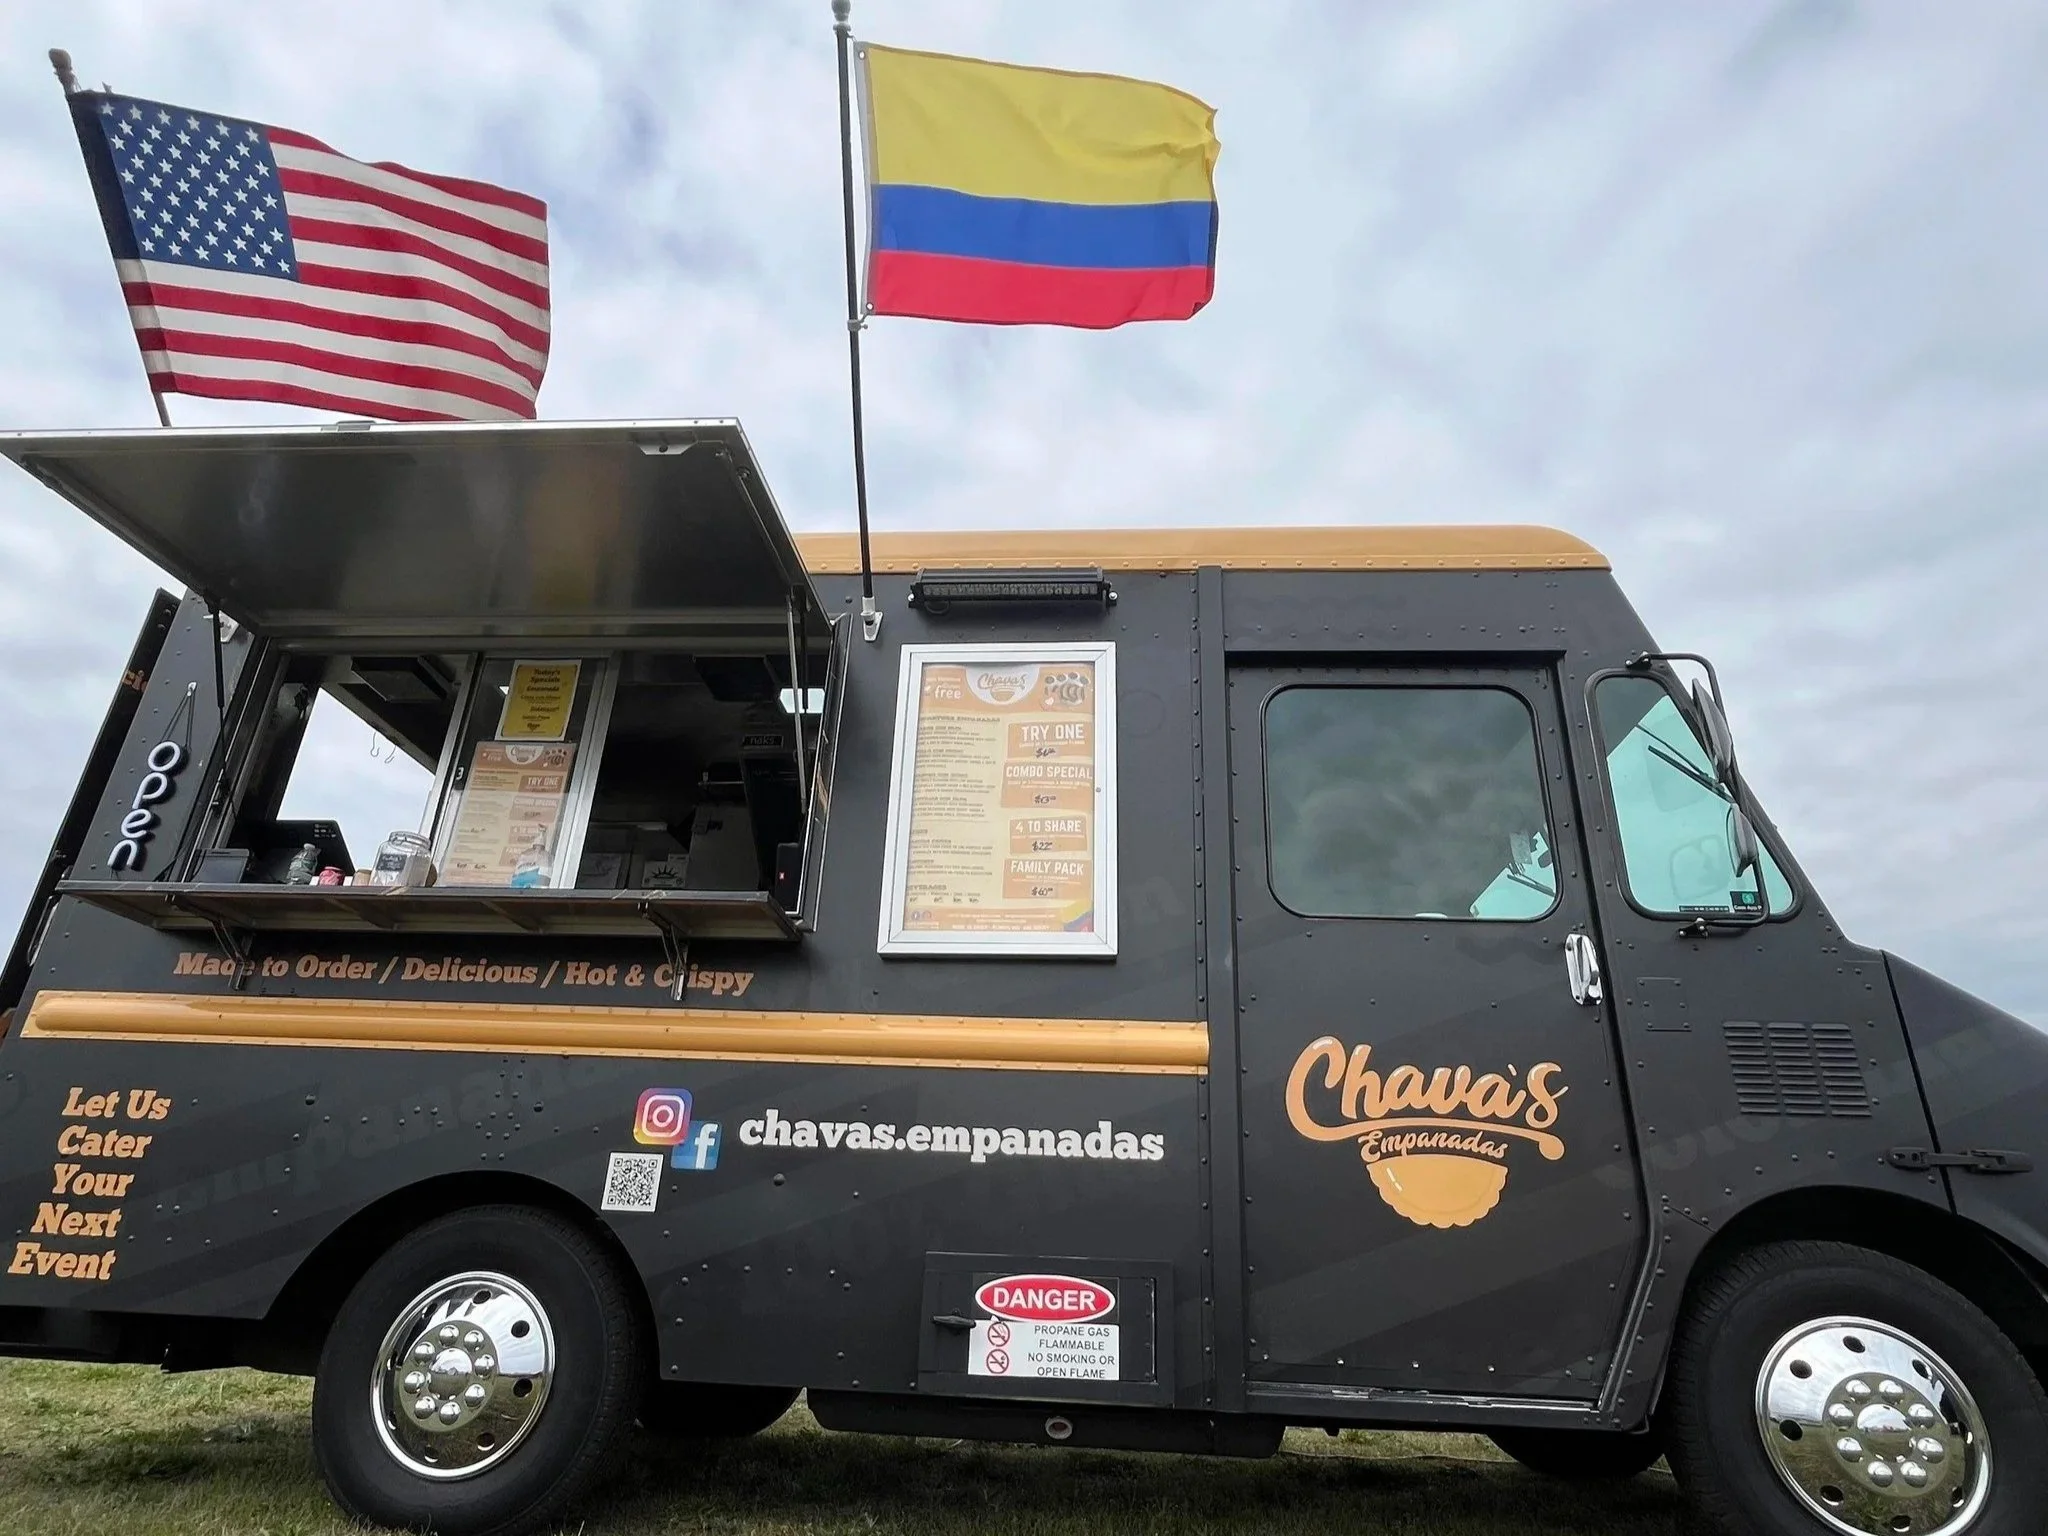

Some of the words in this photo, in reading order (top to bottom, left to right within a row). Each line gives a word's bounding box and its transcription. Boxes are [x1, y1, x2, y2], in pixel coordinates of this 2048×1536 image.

[934, 685, 962, 700] free
[1021, 725, 1051, 742] TRY
[1055, 724, 1085, 741] ONE
[527, 777, 541, 786] TRY
[544, 777, 559, 786] ONE
[1006, 766, 1043, 778] COMBO
[1046, 766, 1093, 780] SPECIAL
[1015, 822, 1024, 833] 4
[1027, 820, 1041, 832] TO
[1044, 820, 1082, 833] SHARE
[1010, 860, 1052, 873] FAMILY
[1054, 862, 1084, 876] PACK
[262, 956, 289, 977] to
[295, 954, 378, 979] Order
[401, 956, 539, 984] Delicious
[563, 961, 619, 986] Hot
[624, 963, 645, 987] &
[653, 963, 754, 996] Cispy
[61, 1086, 120, 1118] Let
[126, 1089, 171, 1120] Us
[1285, 1035, 1569, 1160] Chava's
[57, 1125, 153, 1158] Cater
[739, 1108, 1165, 1163] chavas.empanadas
[1357, 1130, 1509, 1163] Empanadas
[52, 1163, 135, 1197] Your
[30, 1202, 122, 1237] Next
[7, 1241, 116, 1280] Event
[993, 1287, 1096, 1311] DANGER
[1034, 1325, 1084, 1336] PROPANE
[1087, 1327, 1110, 1337] GAS
[1039, 1339, 1105, 1351] FLAMMABLE
[1028, 1353, 1043, 1362] NO
[1046, 1353, 1096, 1364] SMOKING
[1099, 1355, 1115, 1365] OR
[1037, 1367, 1066, 1377] OPEN
[1069, 1368, 1106, 1379] FLAME
